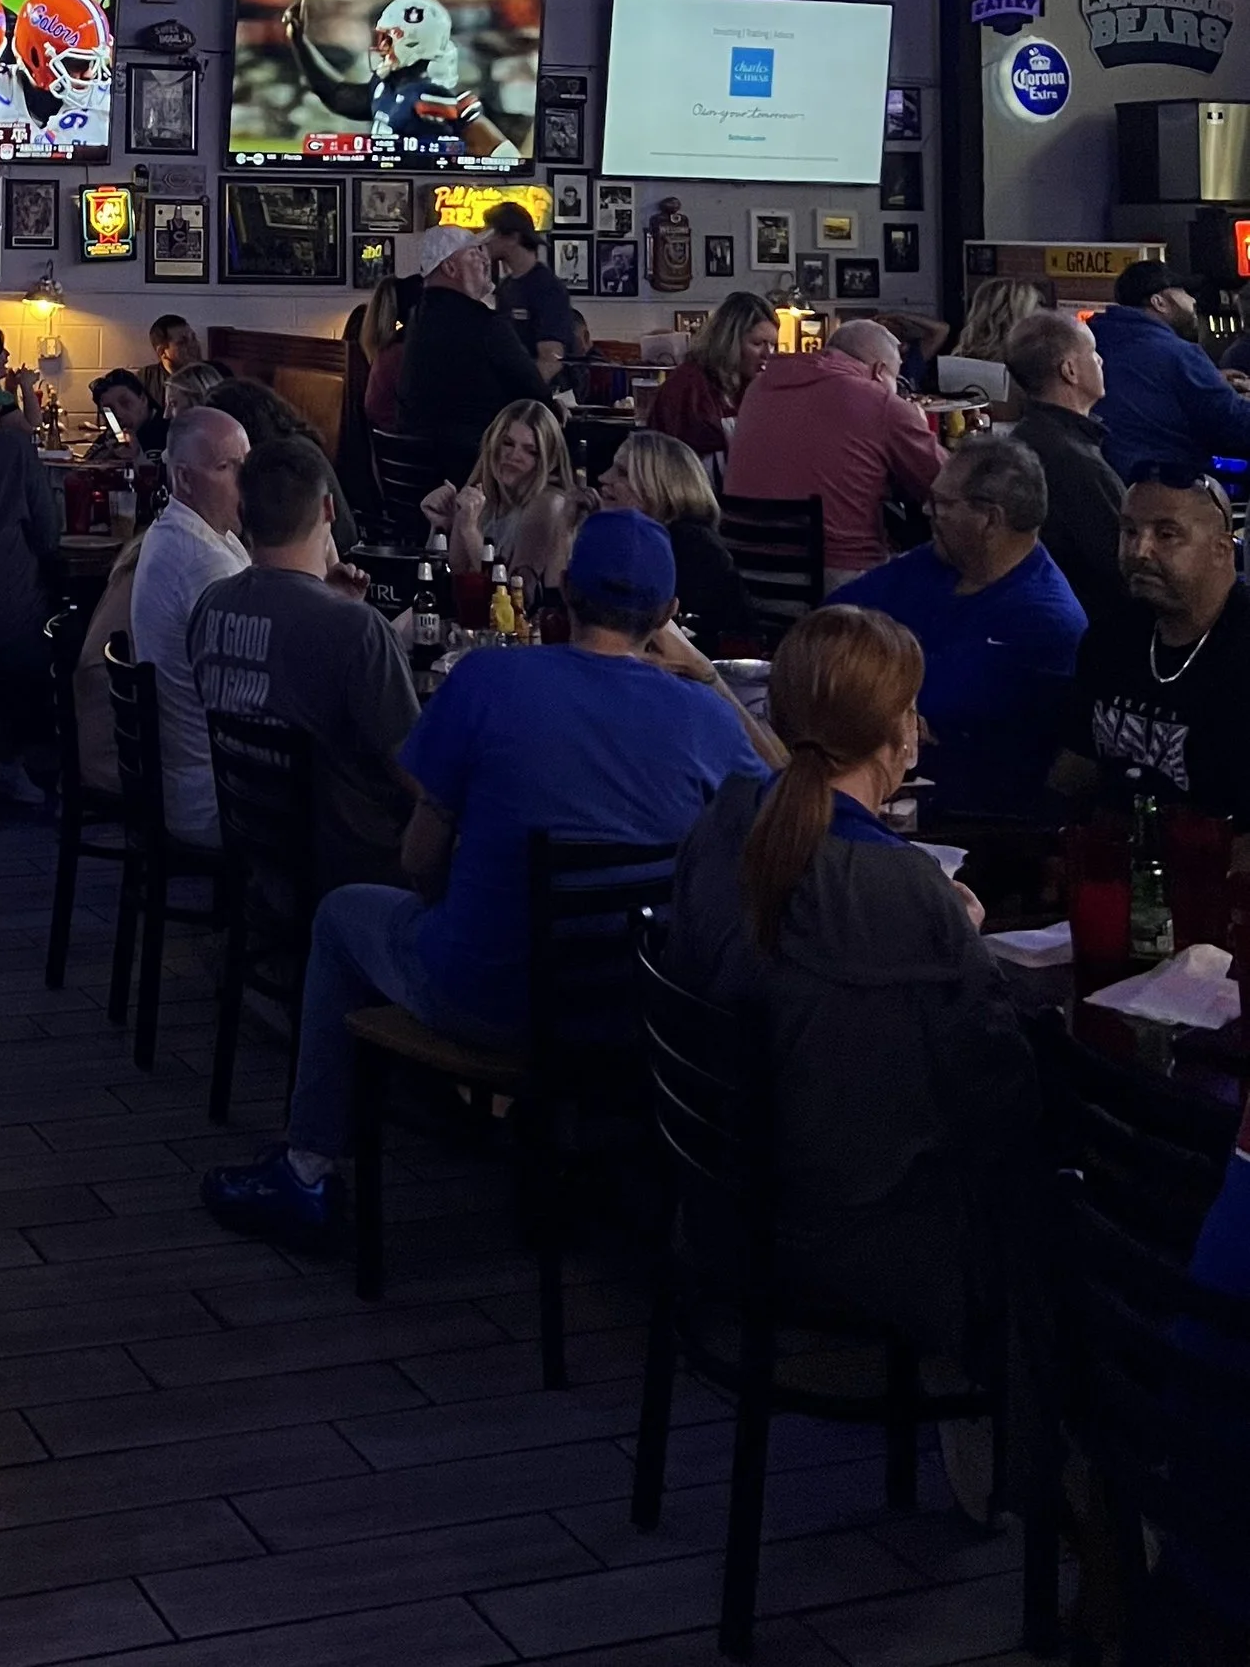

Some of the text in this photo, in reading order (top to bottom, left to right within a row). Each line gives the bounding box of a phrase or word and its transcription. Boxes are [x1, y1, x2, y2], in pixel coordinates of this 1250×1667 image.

[30, 3, 81, 47] Gators
[1090, 7, 1228, 54] BEARS
[734, 61, 769, 73] charles
[1013, 68, 1066, 91] Corona
[1029, 86, 1058, 100] Extra
[403, 136, 419, 152] 10
[1066, 251, 1113, 273] GRACE
[222, 611, 273, 663] GOOD
[220, 665, 271, 716] GOOD
